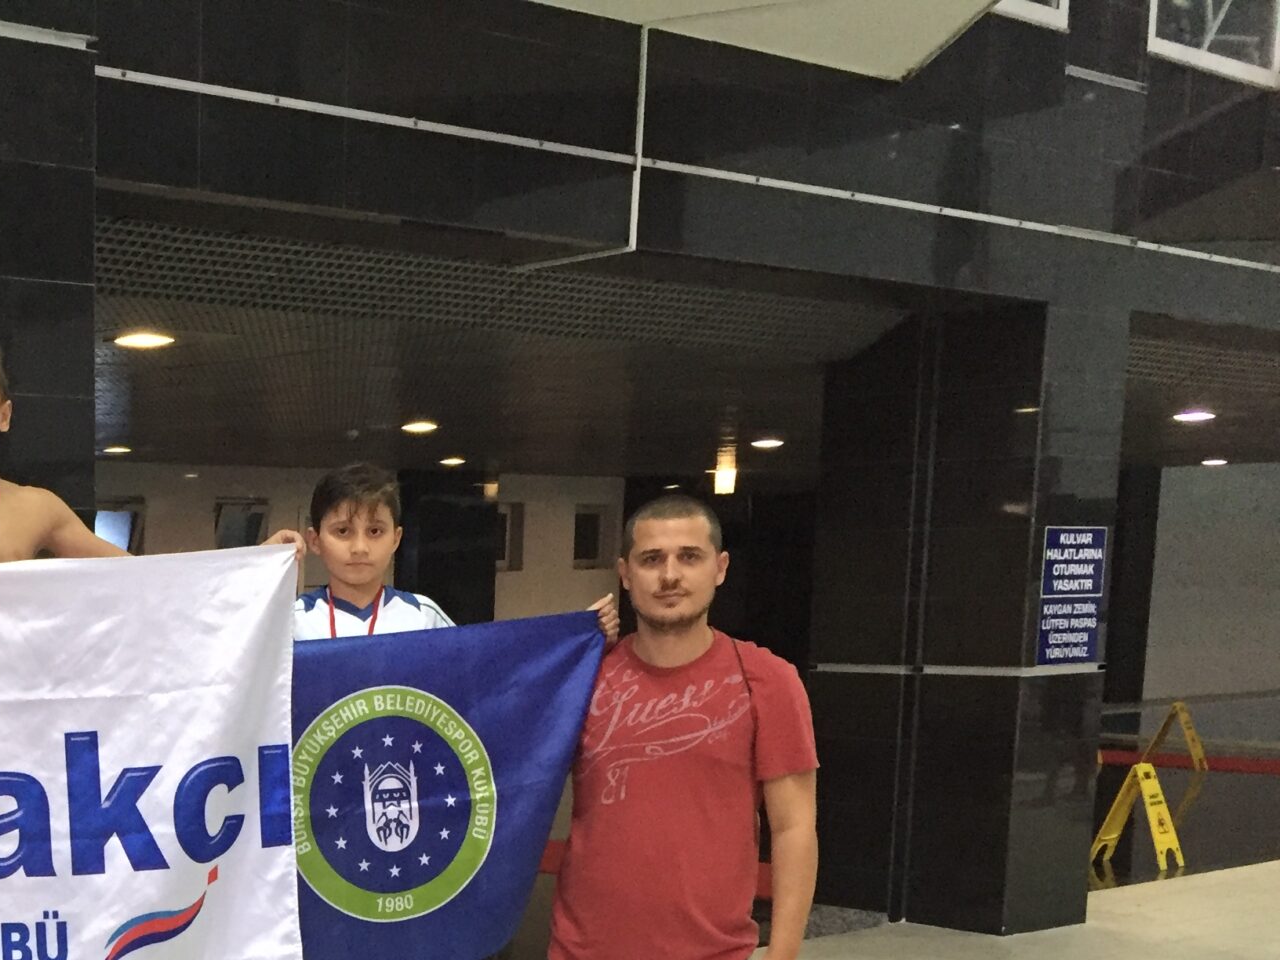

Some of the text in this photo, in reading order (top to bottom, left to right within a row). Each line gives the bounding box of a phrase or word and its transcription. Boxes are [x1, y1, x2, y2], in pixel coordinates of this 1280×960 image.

[1059, 532, 1093, 544] KULVAR
[1046, 548, 1103, 560] HALATLARINA
[1052, 564, 1095, 576] OTURMAK
[1052, 579, 1093, 591] YASAKTIR
[1043, 603, 1072, 615] KAYGAN
[1041, 617, 1097, 630] LÜTFEN PASPAS
[1048, 631, 1089, 644] ÜZERİNDEN
[373, 693, 479, 765] BELEDİYESPOR
[376, 894, 414, 913] 1980
